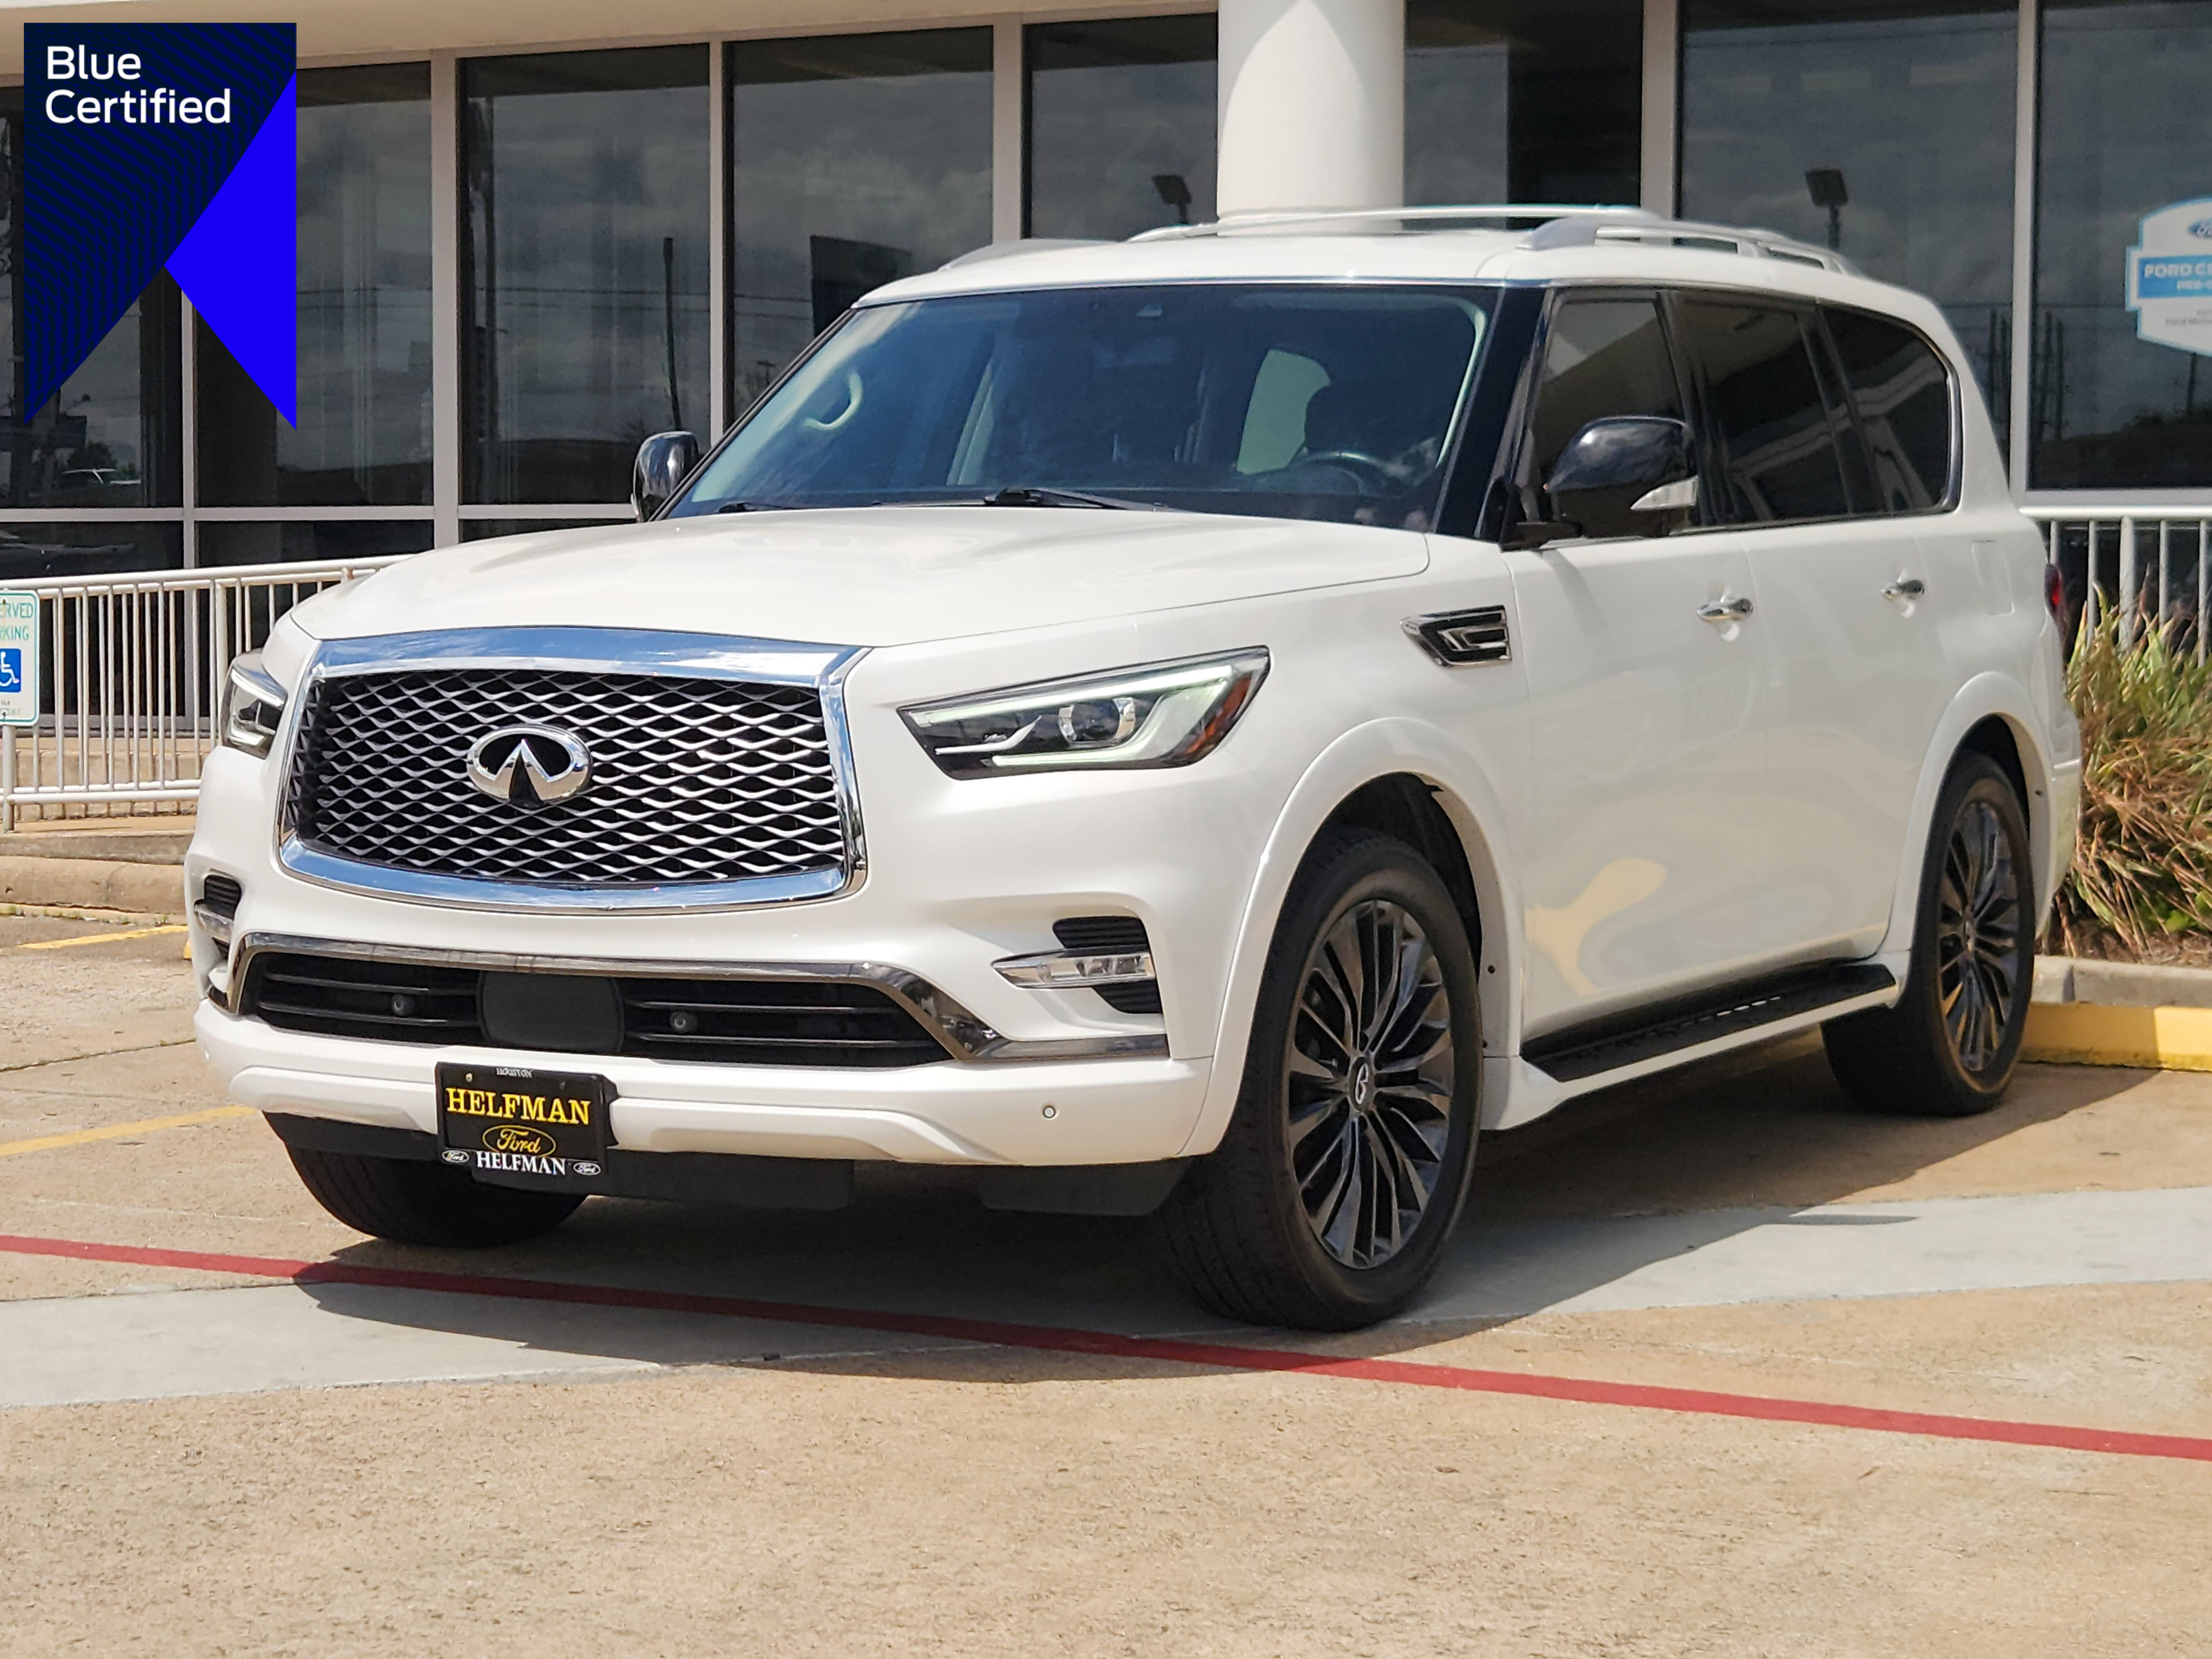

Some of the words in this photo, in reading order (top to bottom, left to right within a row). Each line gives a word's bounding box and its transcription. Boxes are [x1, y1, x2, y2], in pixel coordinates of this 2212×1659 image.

[2144, 263, 2192, 278] FORD
[445, 1088, 591, 1125] HELFMAN
[497, 1128, 541, 1153] Ford
[475, 1151, 566, 1176] HELFMAN
